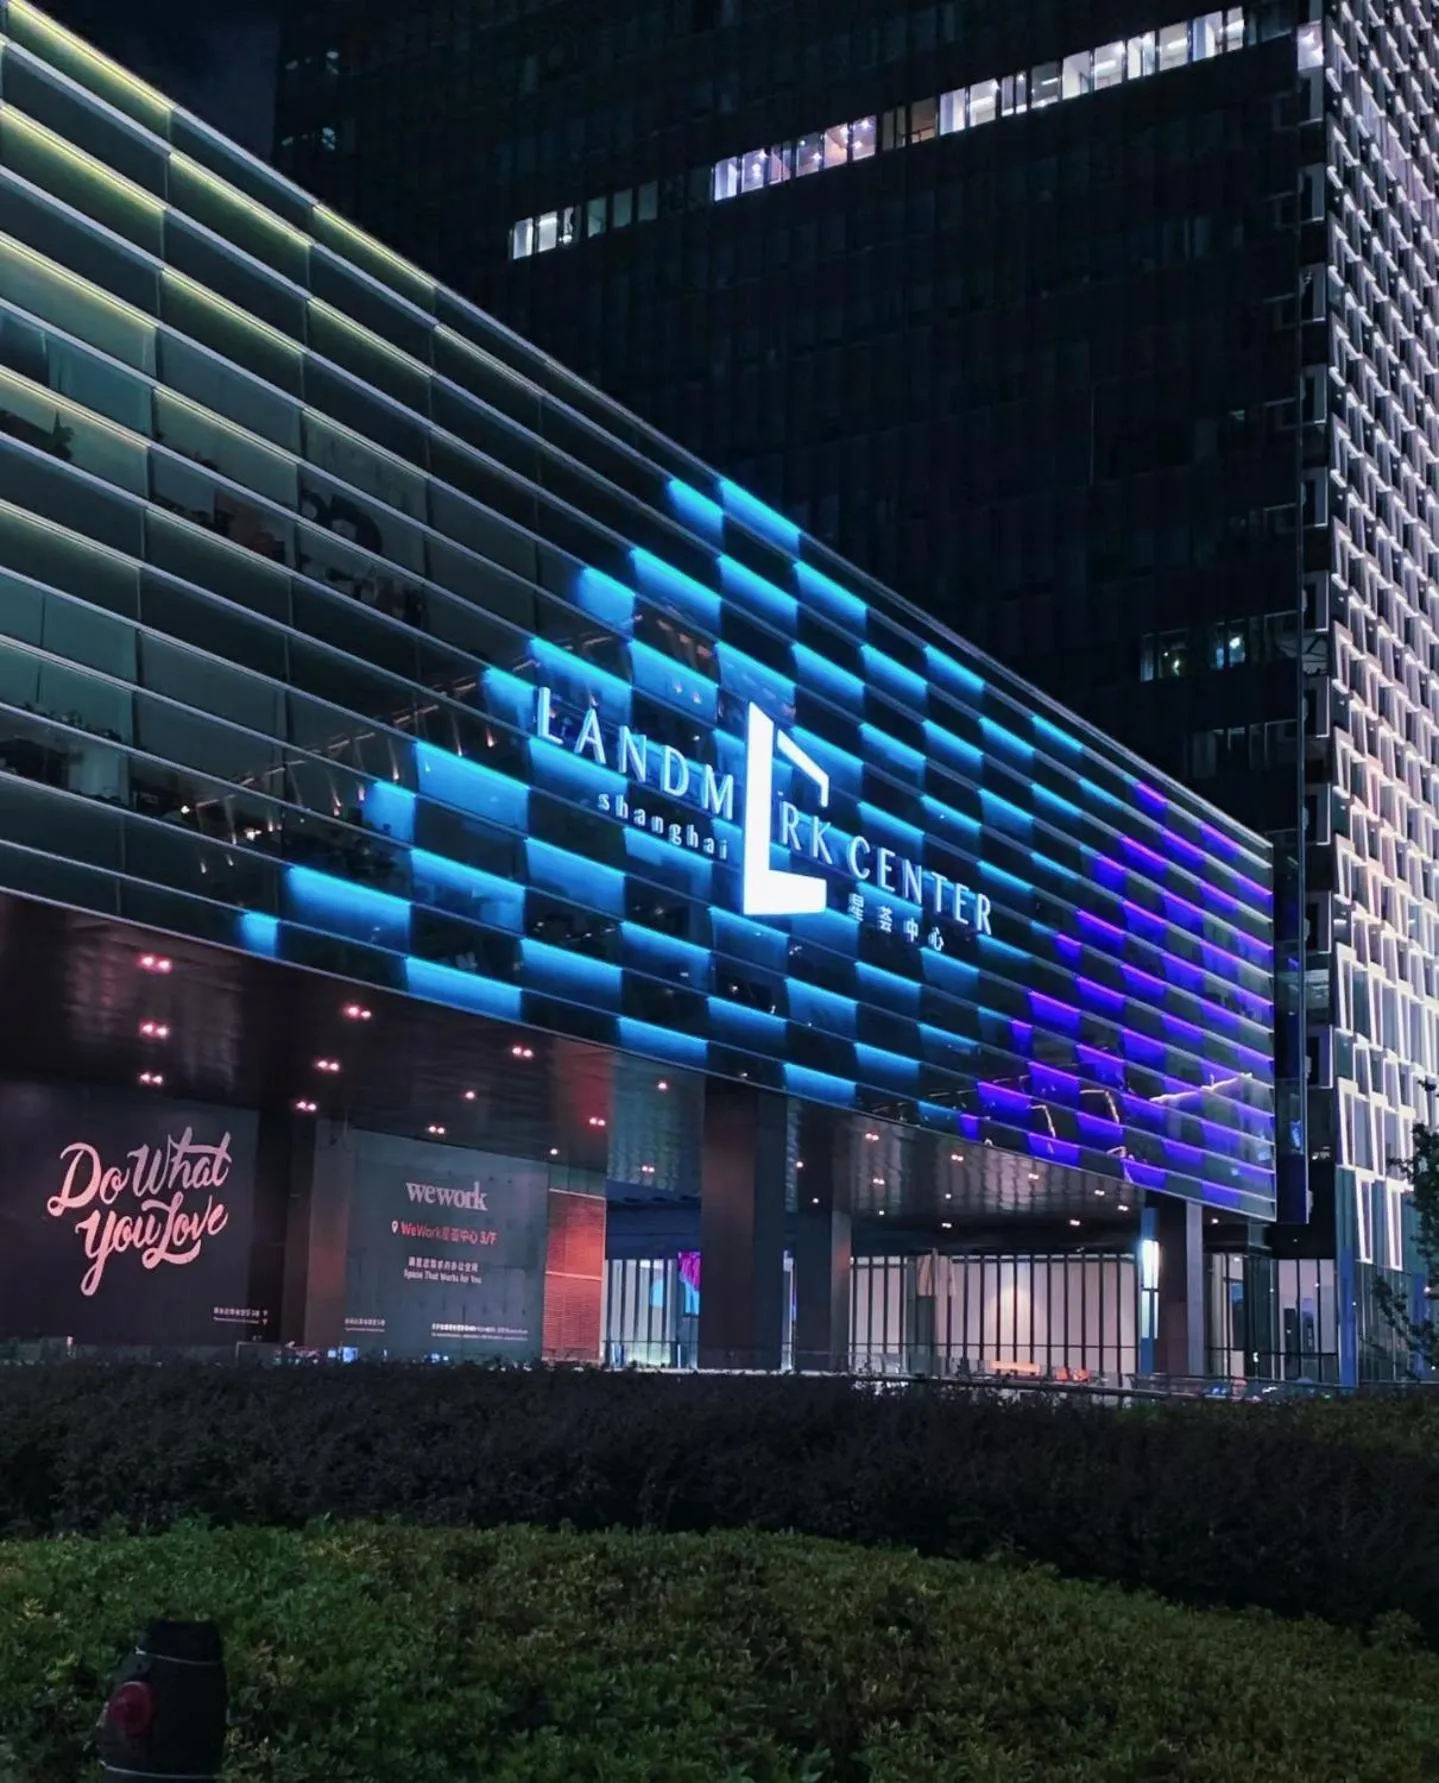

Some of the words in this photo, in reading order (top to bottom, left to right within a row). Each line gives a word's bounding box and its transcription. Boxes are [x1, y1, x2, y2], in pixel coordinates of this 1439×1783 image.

[598, 793, 728, 860] shanghai
[846, 836, 992, 935] CENTER
[848, 893, 944, 951] 星荟中心
[47, 1142, 130, 1217] Do
[127, 1126, 232, 1197] What
[405, 1181, 488, 1211] wework
[75, 1209, 161, 1297] You
[141, 1191, 229, 1269] Love
